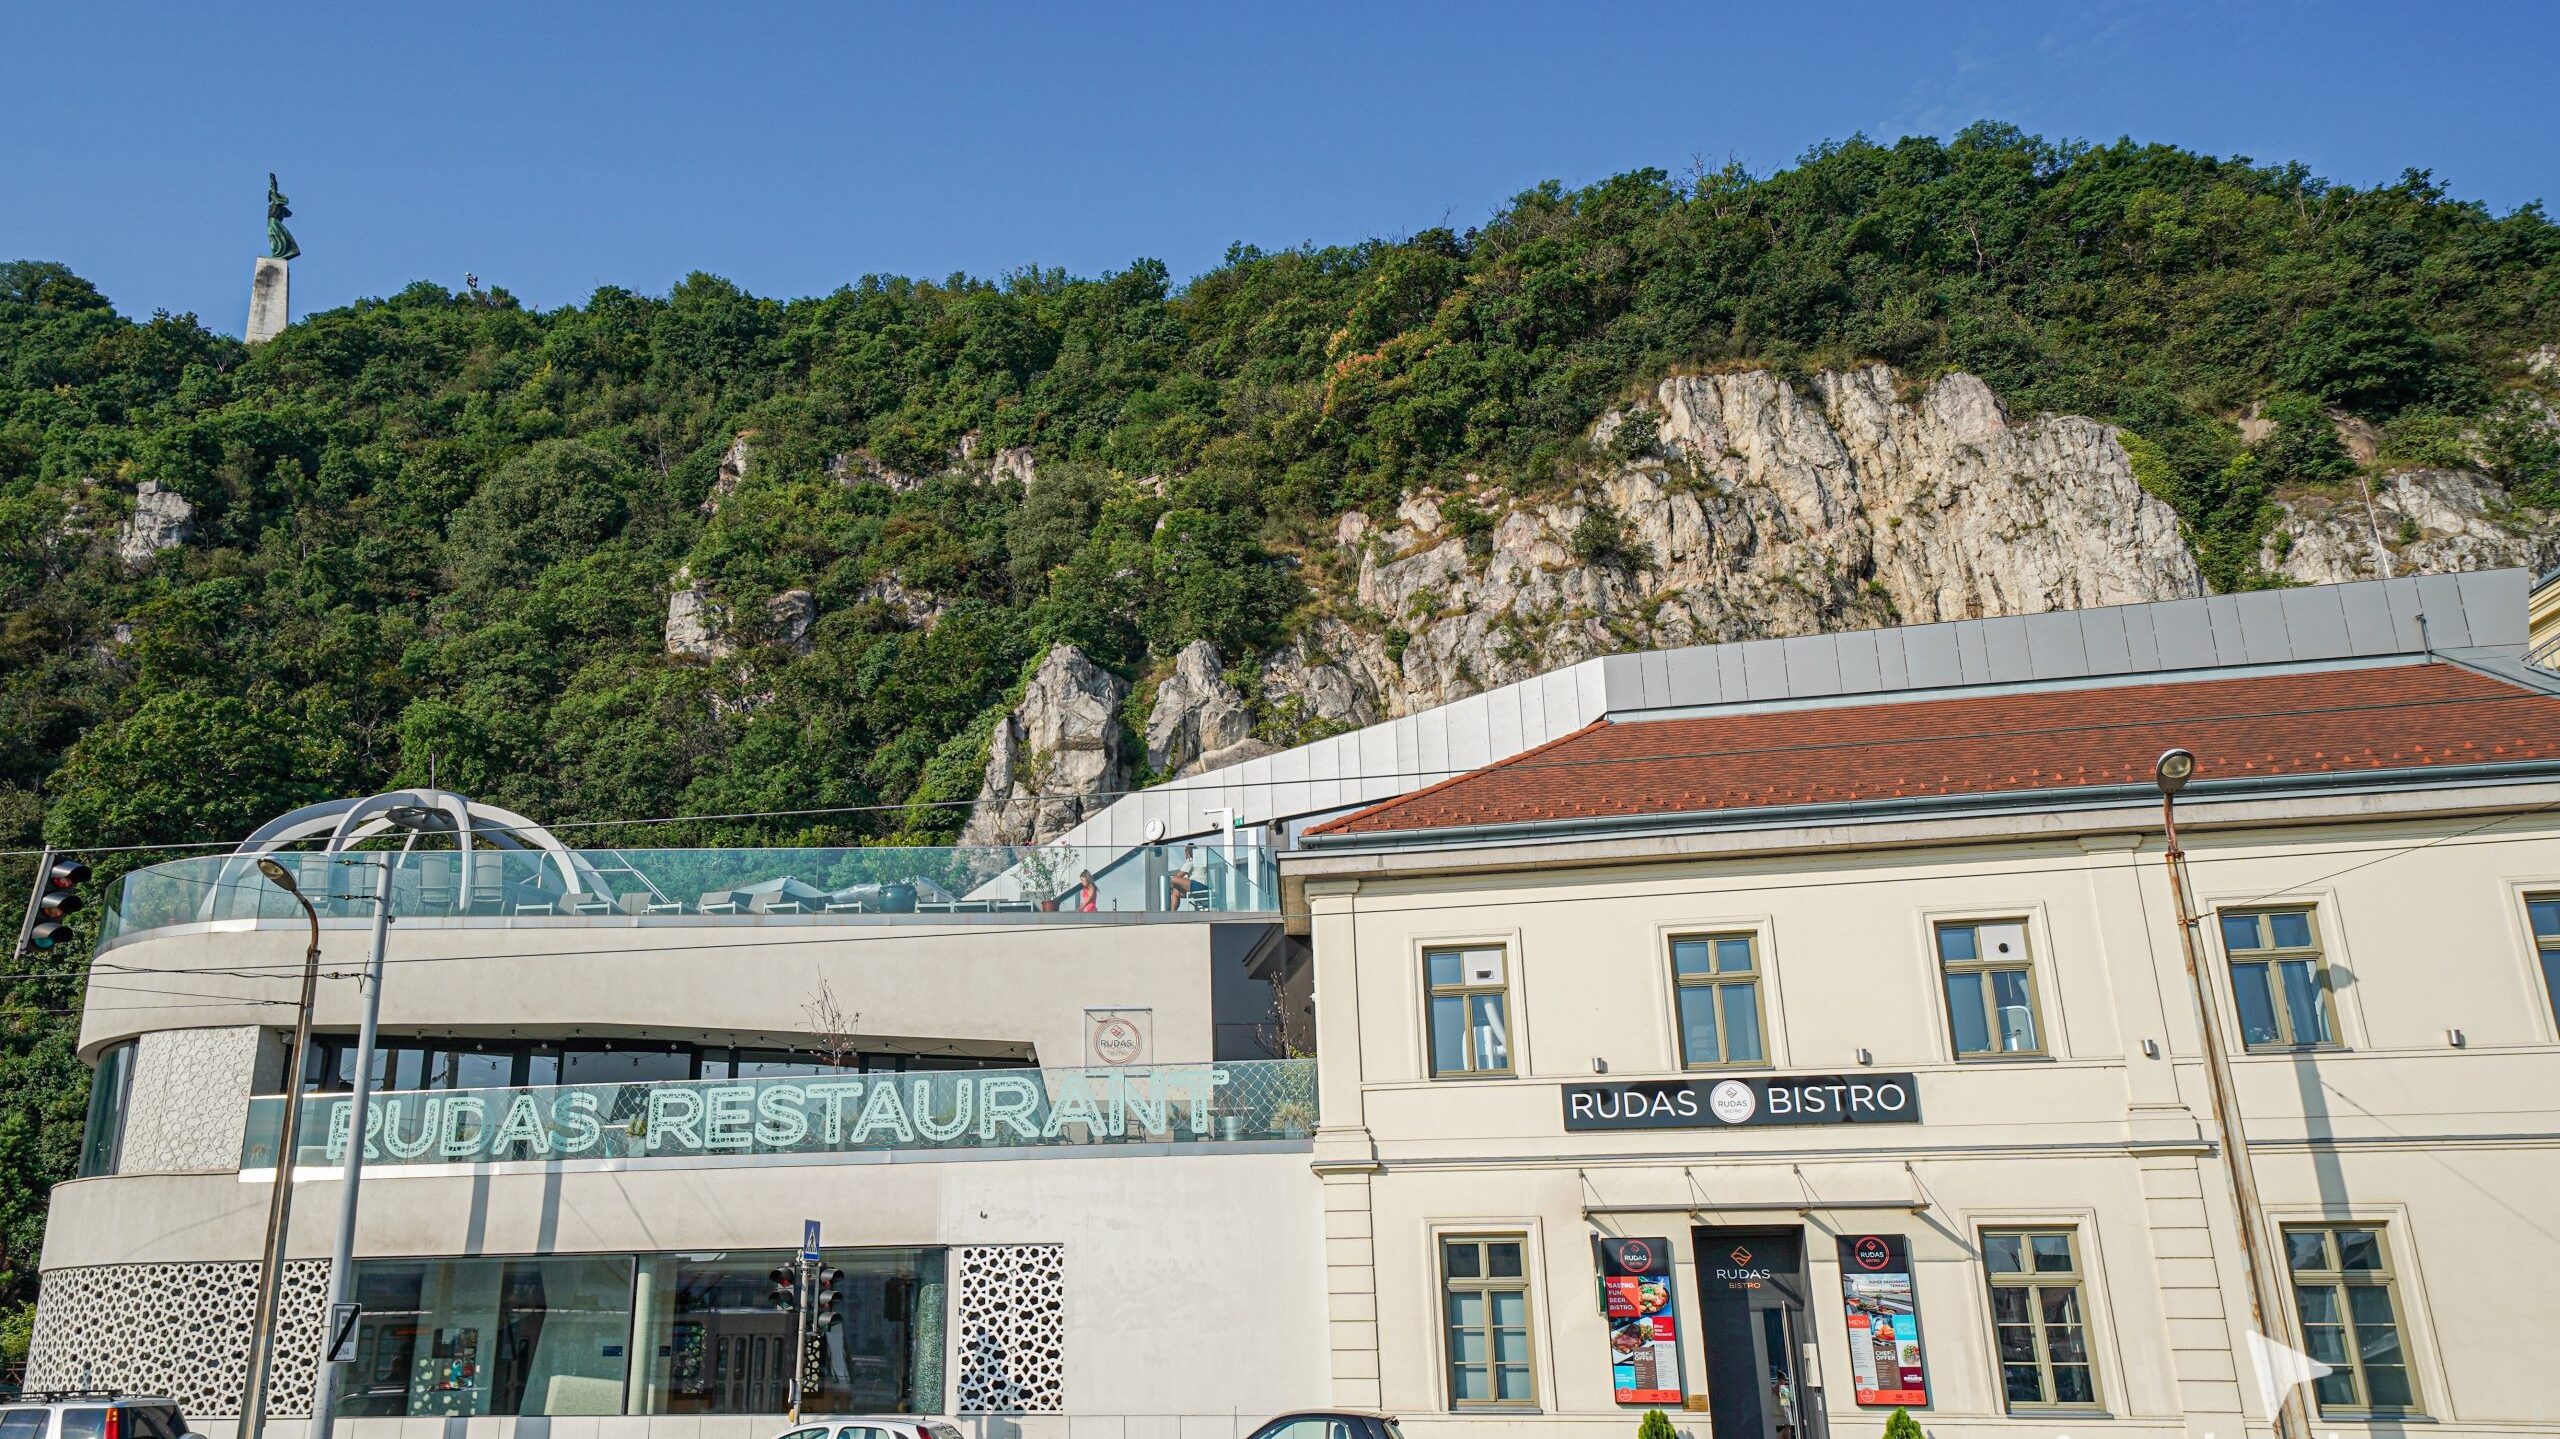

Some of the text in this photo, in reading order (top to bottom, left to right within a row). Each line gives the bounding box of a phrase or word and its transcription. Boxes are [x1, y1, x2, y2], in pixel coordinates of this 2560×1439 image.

[1101, 1039, 1132, 1047] RUDAS
[1571, 1083, 1906, 1119] RUDAS BISTRO
[1717, 1099, 1748, 1107] RUDAS
[326, 1069, 1229, 1160] RUDAS RESTAURANT
[1716, 1269, 1771, 1280] RUDAS
